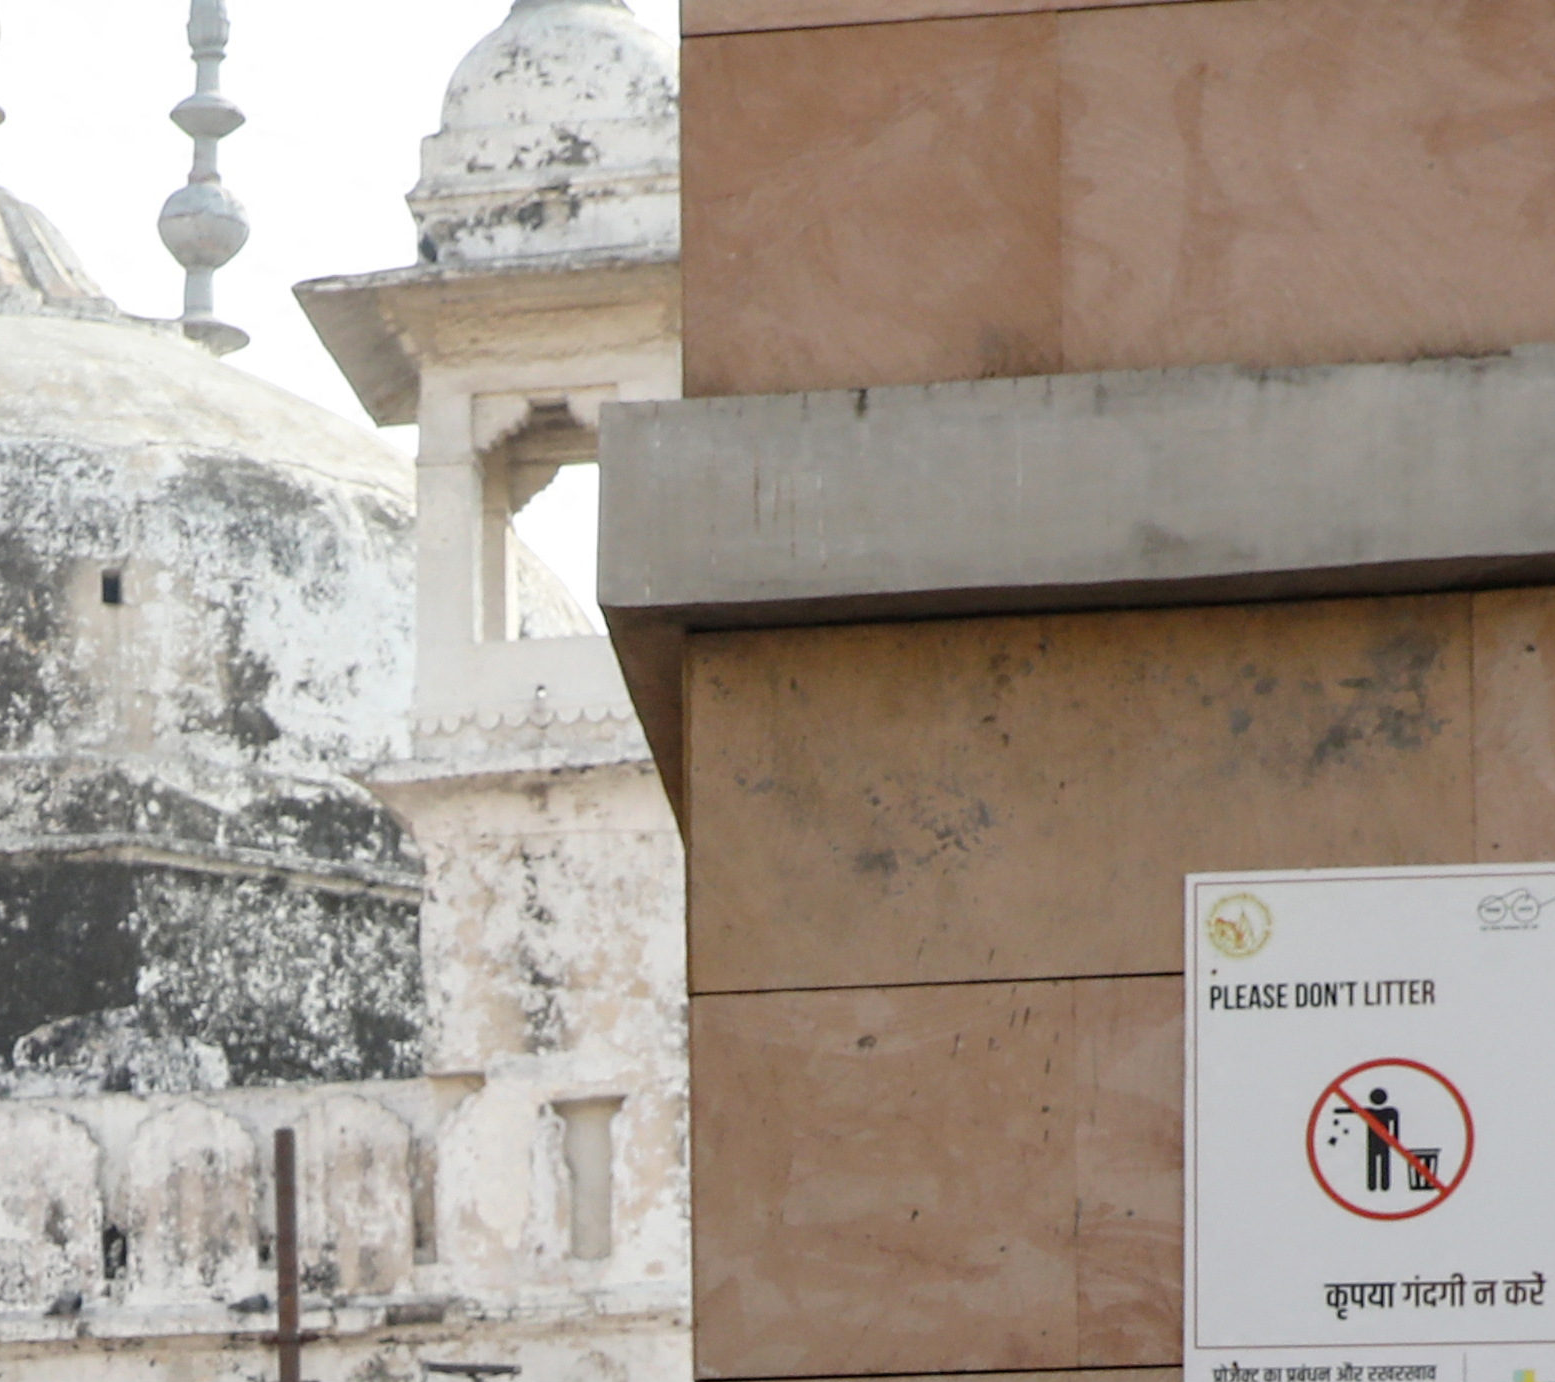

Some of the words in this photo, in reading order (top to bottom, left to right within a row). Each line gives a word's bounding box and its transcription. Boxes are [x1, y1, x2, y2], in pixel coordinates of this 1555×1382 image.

[1209, 983, 1288, 1010] PLEASE
[1295, 981, 1358, 1008] DON'T
[1364, 979, 1436, 1006] LITTER
[1324, 1281, 1395, 1319] कृपया
[1401, 1273, 1466, 1308] गंदगी
[1472, 1279, 1498, 1306] न
[1503, 1272, 1547, 1306] करें
[1263, 1367, 1281, 1382] का
[1286, 1363, 1331, 1382] प्रबंधन
[1336, 1362, 1364, 1382] और
